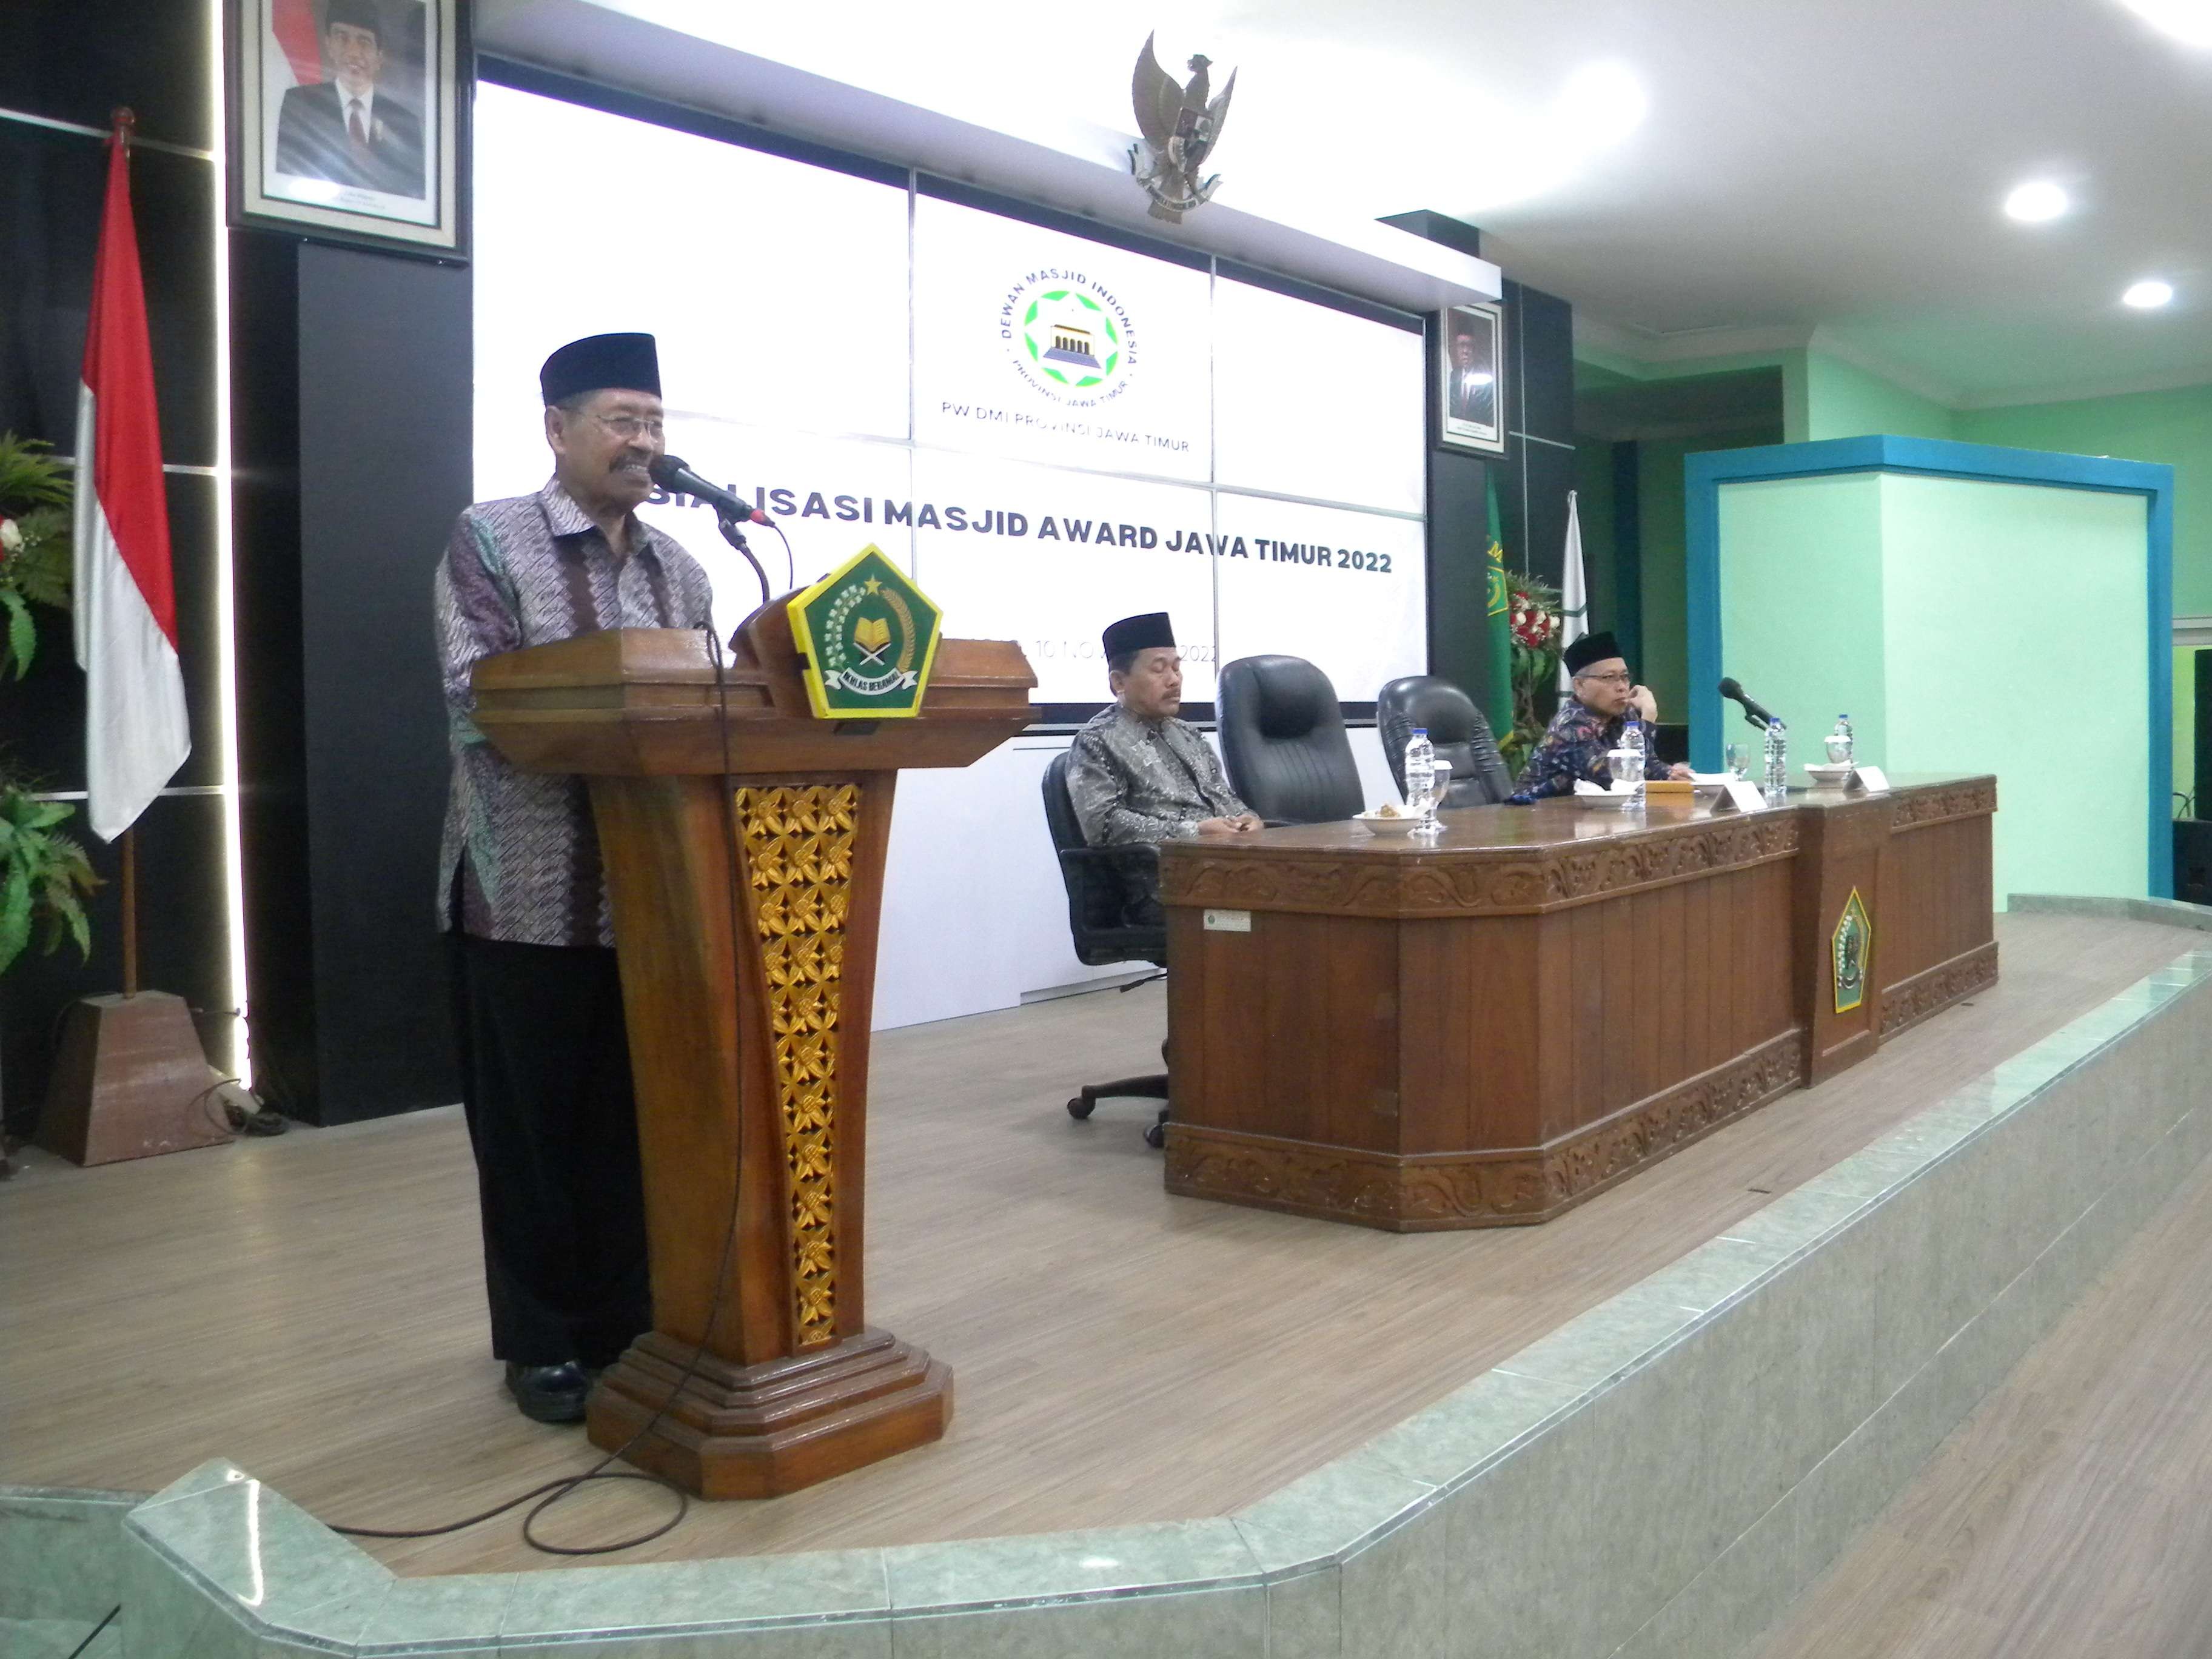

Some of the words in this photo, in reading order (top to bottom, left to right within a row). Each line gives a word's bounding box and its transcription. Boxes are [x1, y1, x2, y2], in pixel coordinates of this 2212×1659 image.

[1000, 283, 1025, 338] DEWAN
[1026, 269, 1086, 284] MASJID
[1091, 281, 1138, 364] INDONESIA
[1066, 399, 1097, 407] JAWA
[1099, 381, 1128, 403] TIMUR
[942, 402, 970, 417] PW
[976, 407, 1008, 423] DMI
[1096, 426, 1139, 443] JAWA
[1145, 435, 1189, 452] TIMUR
[885, 498, 1028, 537] MASJID
[1038, 516, 1158, 550] AWARD
[1165, 530, 1249, 559] JAWA
[1255, 538, 1332, 567] TIMUR
[1337, 549, 1392, 573] 2022
[1036, 640, 1056, 659] 10
